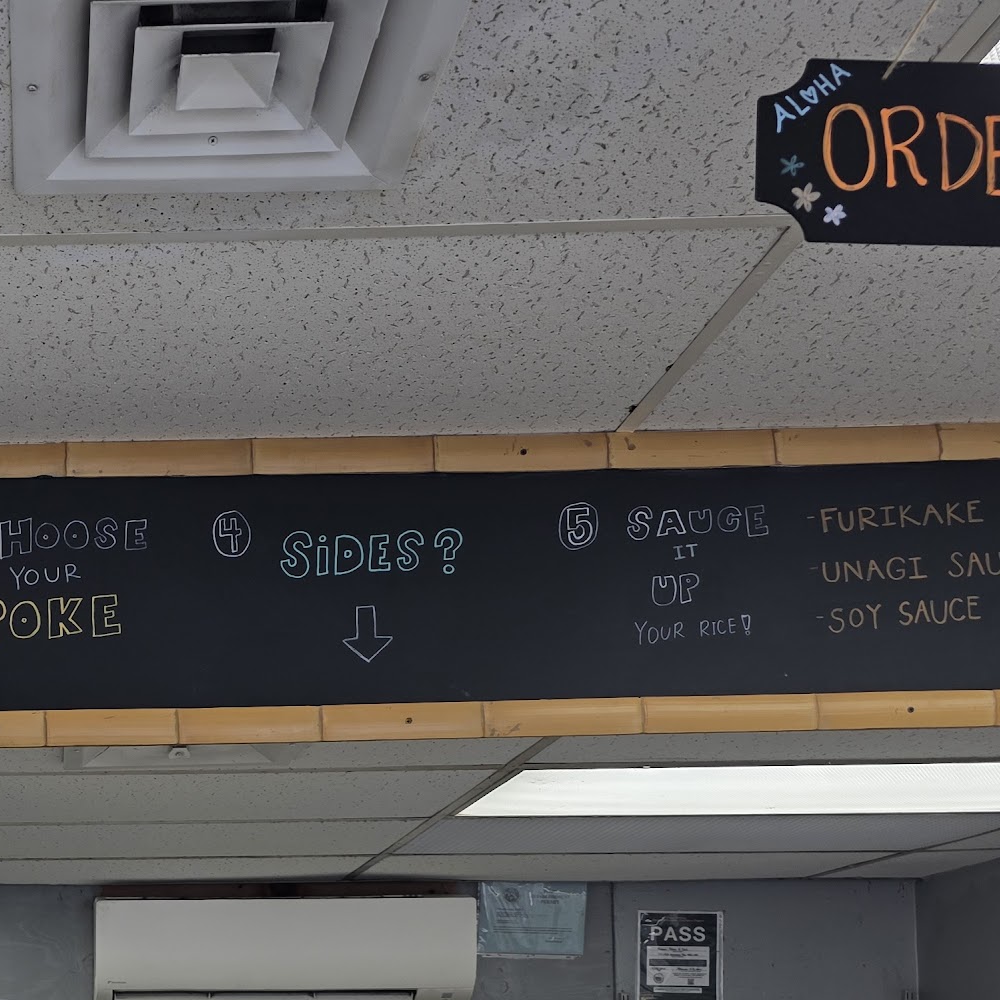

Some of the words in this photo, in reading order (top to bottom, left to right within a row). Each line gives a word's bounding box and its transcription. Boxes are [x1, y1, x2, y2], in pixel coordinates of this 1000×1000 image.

[626, 504, 769, 541] SAUCE
[673, 543, 698, 560] IT
[9, 564, 81, 590] YOUR
[652, 573, 700, 606] UP
[899, 595, 982, 626] SAUCE
[634, 620, 685, 645] YOUR
[700, 614, 751, 637] RICE!
[650, 926, 706, 942] PASS
